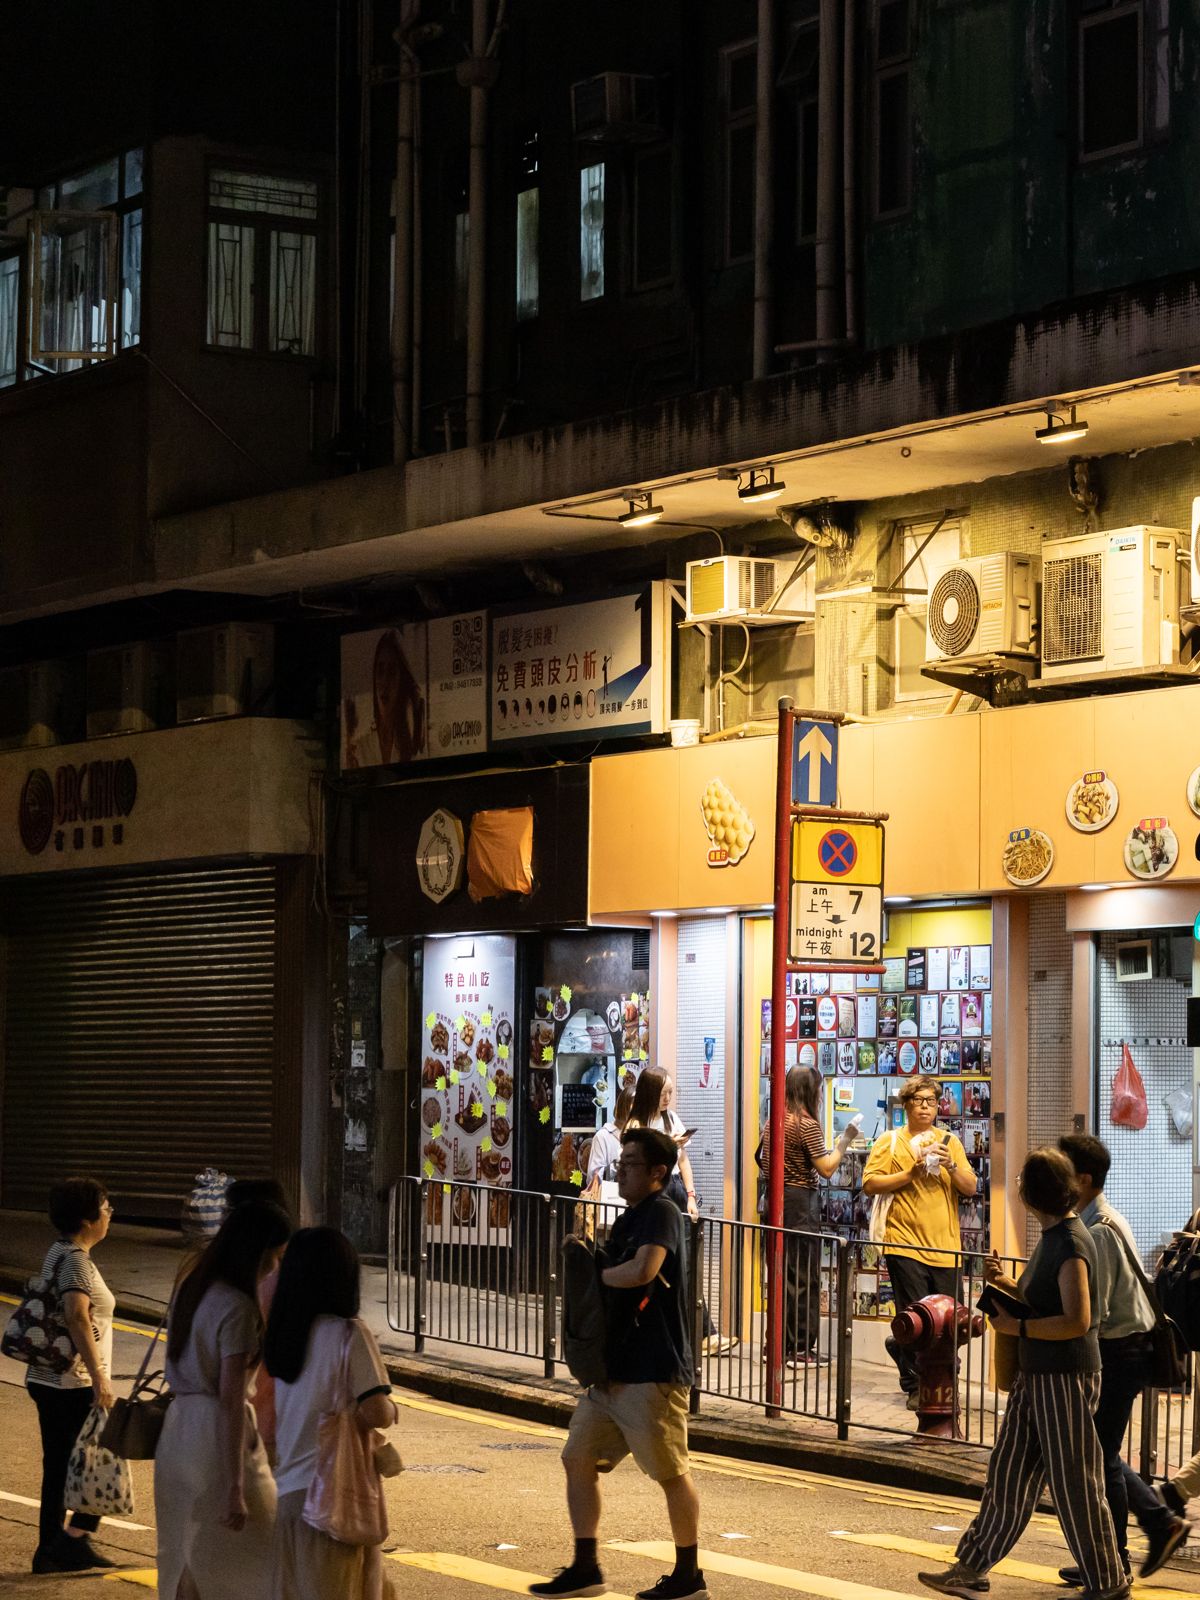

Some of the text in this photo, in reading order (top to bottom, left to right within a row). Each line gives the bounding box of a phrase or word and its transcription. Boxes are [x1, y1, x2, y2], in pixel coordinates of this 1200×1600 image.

[496, 649, 598, 693] 免費頭皮分析
[806, 898, 833, 915] 上午
[812, 886, 864, 915] am 7
[795, 926, 876, 957] midnight 12
[805, 940, 833, 956] 午夜
[444, 971, 491, 988] 特色小吃
